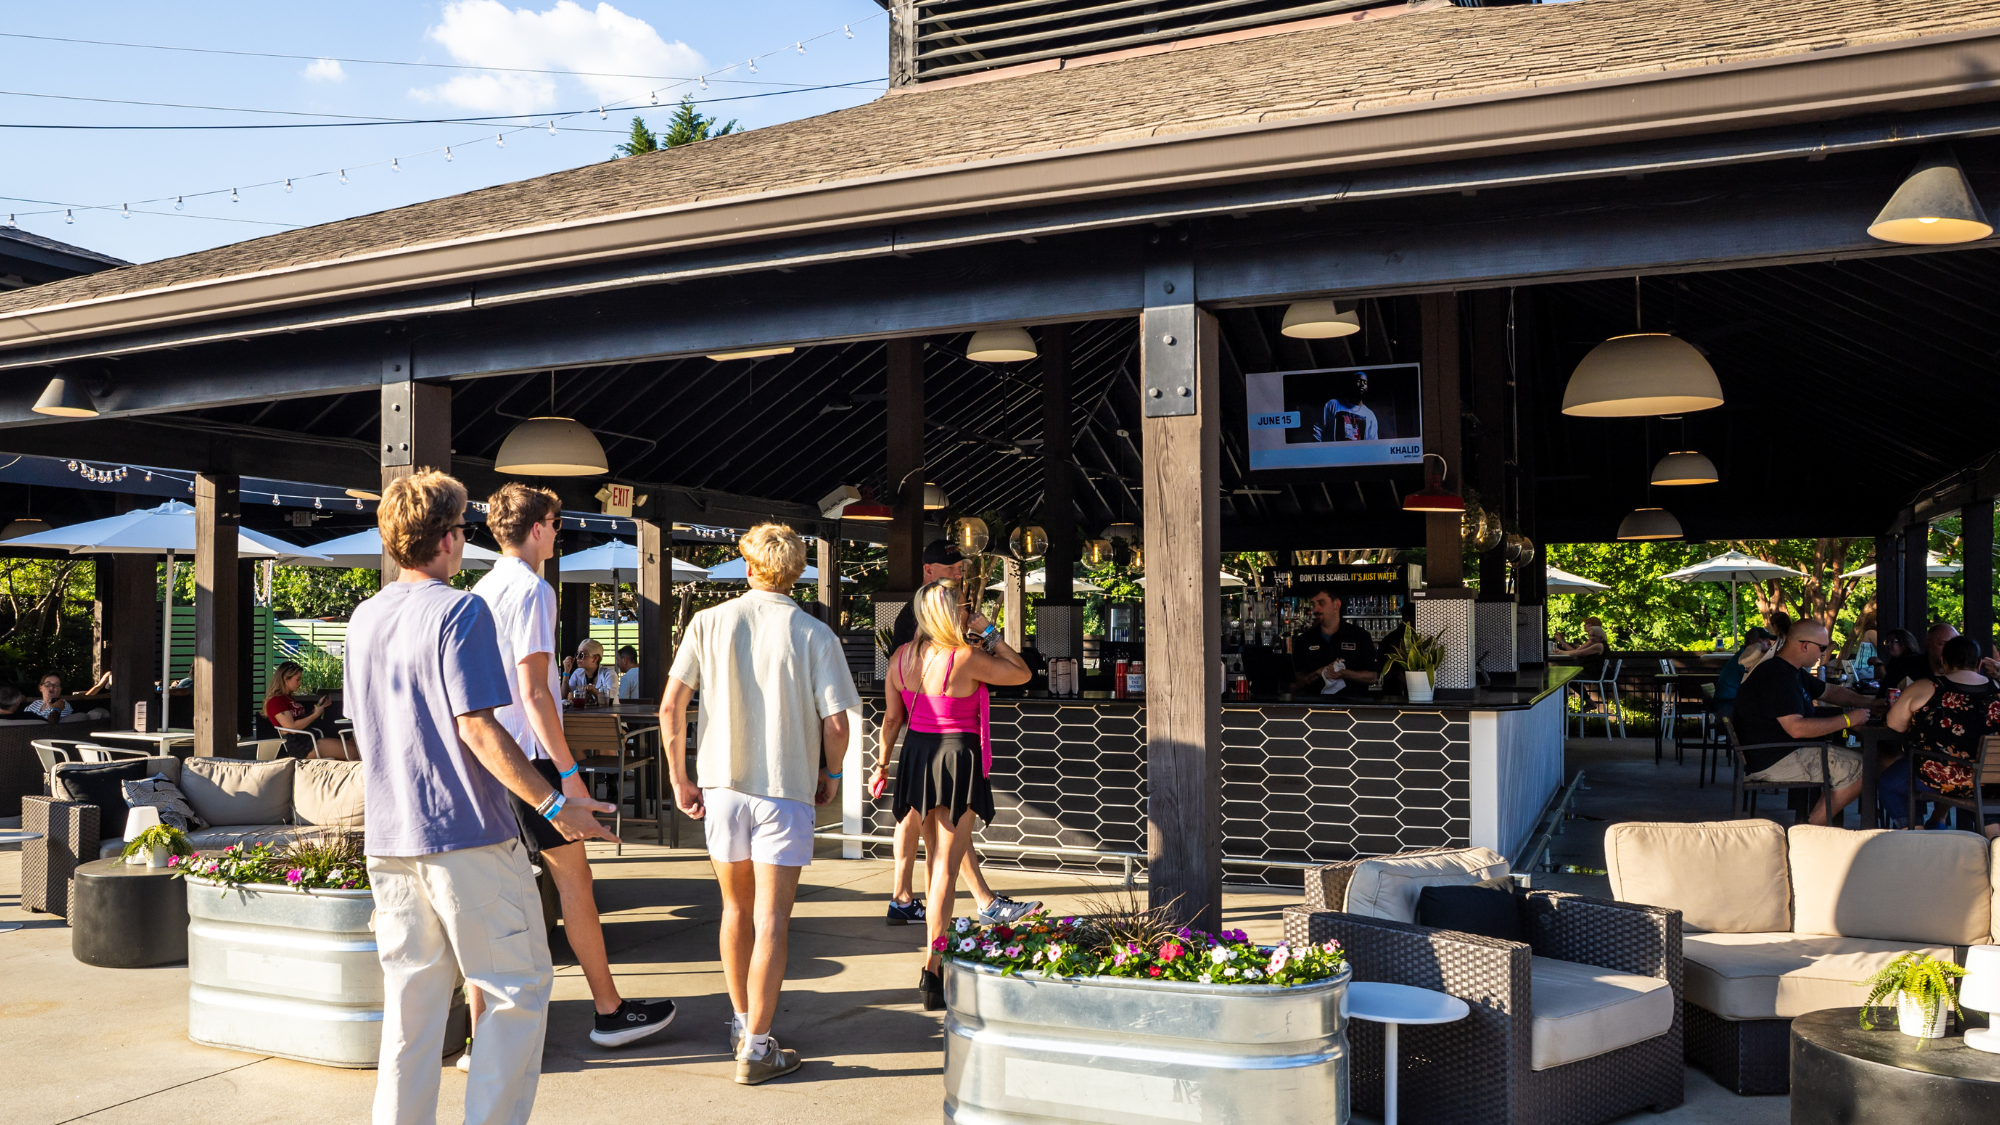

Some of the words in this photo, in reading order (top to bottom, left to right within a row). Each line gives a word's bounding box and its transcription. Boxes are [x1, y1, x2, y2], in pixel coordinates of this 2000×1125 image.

[1258, 416, 1280, 426] JUNE
[1281, 415, 1292, 425] 15
[1390, 445, 1420, 455] KHALID
[612, 486, 630, 508] EXIT
[1299, 573, 1318, 582] DON'T
[1318, 573, 1326, 582] BE
[1326, 573, 1350, 582] SCARED.
[1351, 572, 1363, 581] IT'S
[1363, 572, 1376, 581] JUST
[1377, 571, 1399, 581] WATER.
